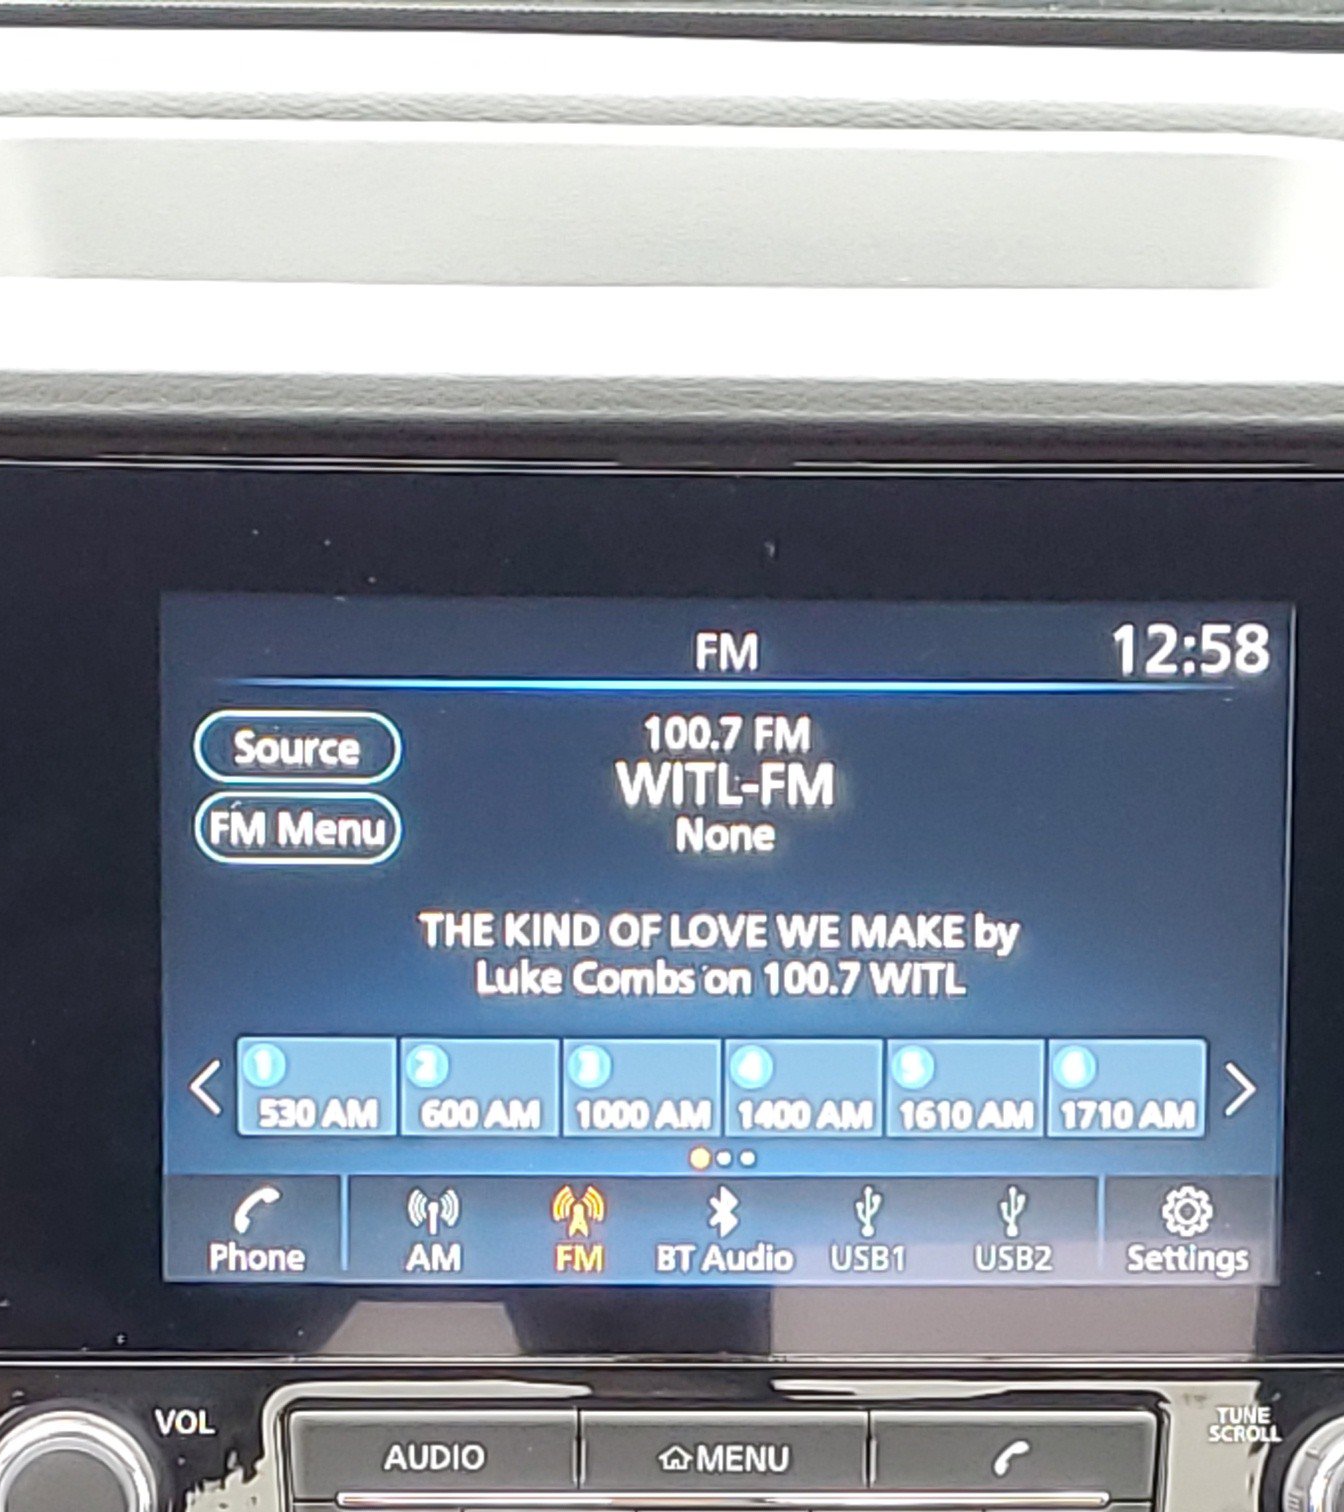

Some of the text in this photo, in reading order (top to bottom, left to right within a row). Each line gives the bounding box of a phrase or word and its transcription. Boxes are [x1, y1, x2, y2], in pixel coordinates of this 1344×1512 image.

[696, 633, 759, 671] FM
[1113, 623, 1271, 676] 12:58
[233, 730, 362, 766] Source
[645, 716, 811, 752] 100.7 FM
[615, 760, 835, 808] WITL-FM
[210, 811, 386, 847] FM Menu
[675, 817, 776, 853] None
[418, 912, 1021, 956] THE KIND OF LOVE WE MAKE by
[477, 960, 967, 997] Luke Combs on 100.7 WITL
[259, 1099, 378, 1130] 530 AM
[420, 1099, 540, 1130] 600 AM
[577, 1099, 711, 1130] 1000 AM
[738, 1099, 873, 1130] 1400 AM
[899, 1099, 1034, 1130] 1610 AM
[1060, 1099, 1196, 1130] 1710 AM
[209, 1242, 306, 1272] Phone
[406, 1244, 461, 1272] AM
[557, 1244, 604, 1272] FM
[657, 1242, 795, 1273] BT Audio
[831, 1244, 905, 1272] USB1
[975, 1244, 1053, 1272] USB2
[1127, 1243, 1250, 1277] Settings
[155, 1409, 216, 1436] VOL
[1216, 1406, 1272, 1425] TUNE
[1208, 1425, 1283, 1443] SCROLL
[383, 1444, 486, 1471] AUDIO
[696, 1445, 790, 1473] MENU
